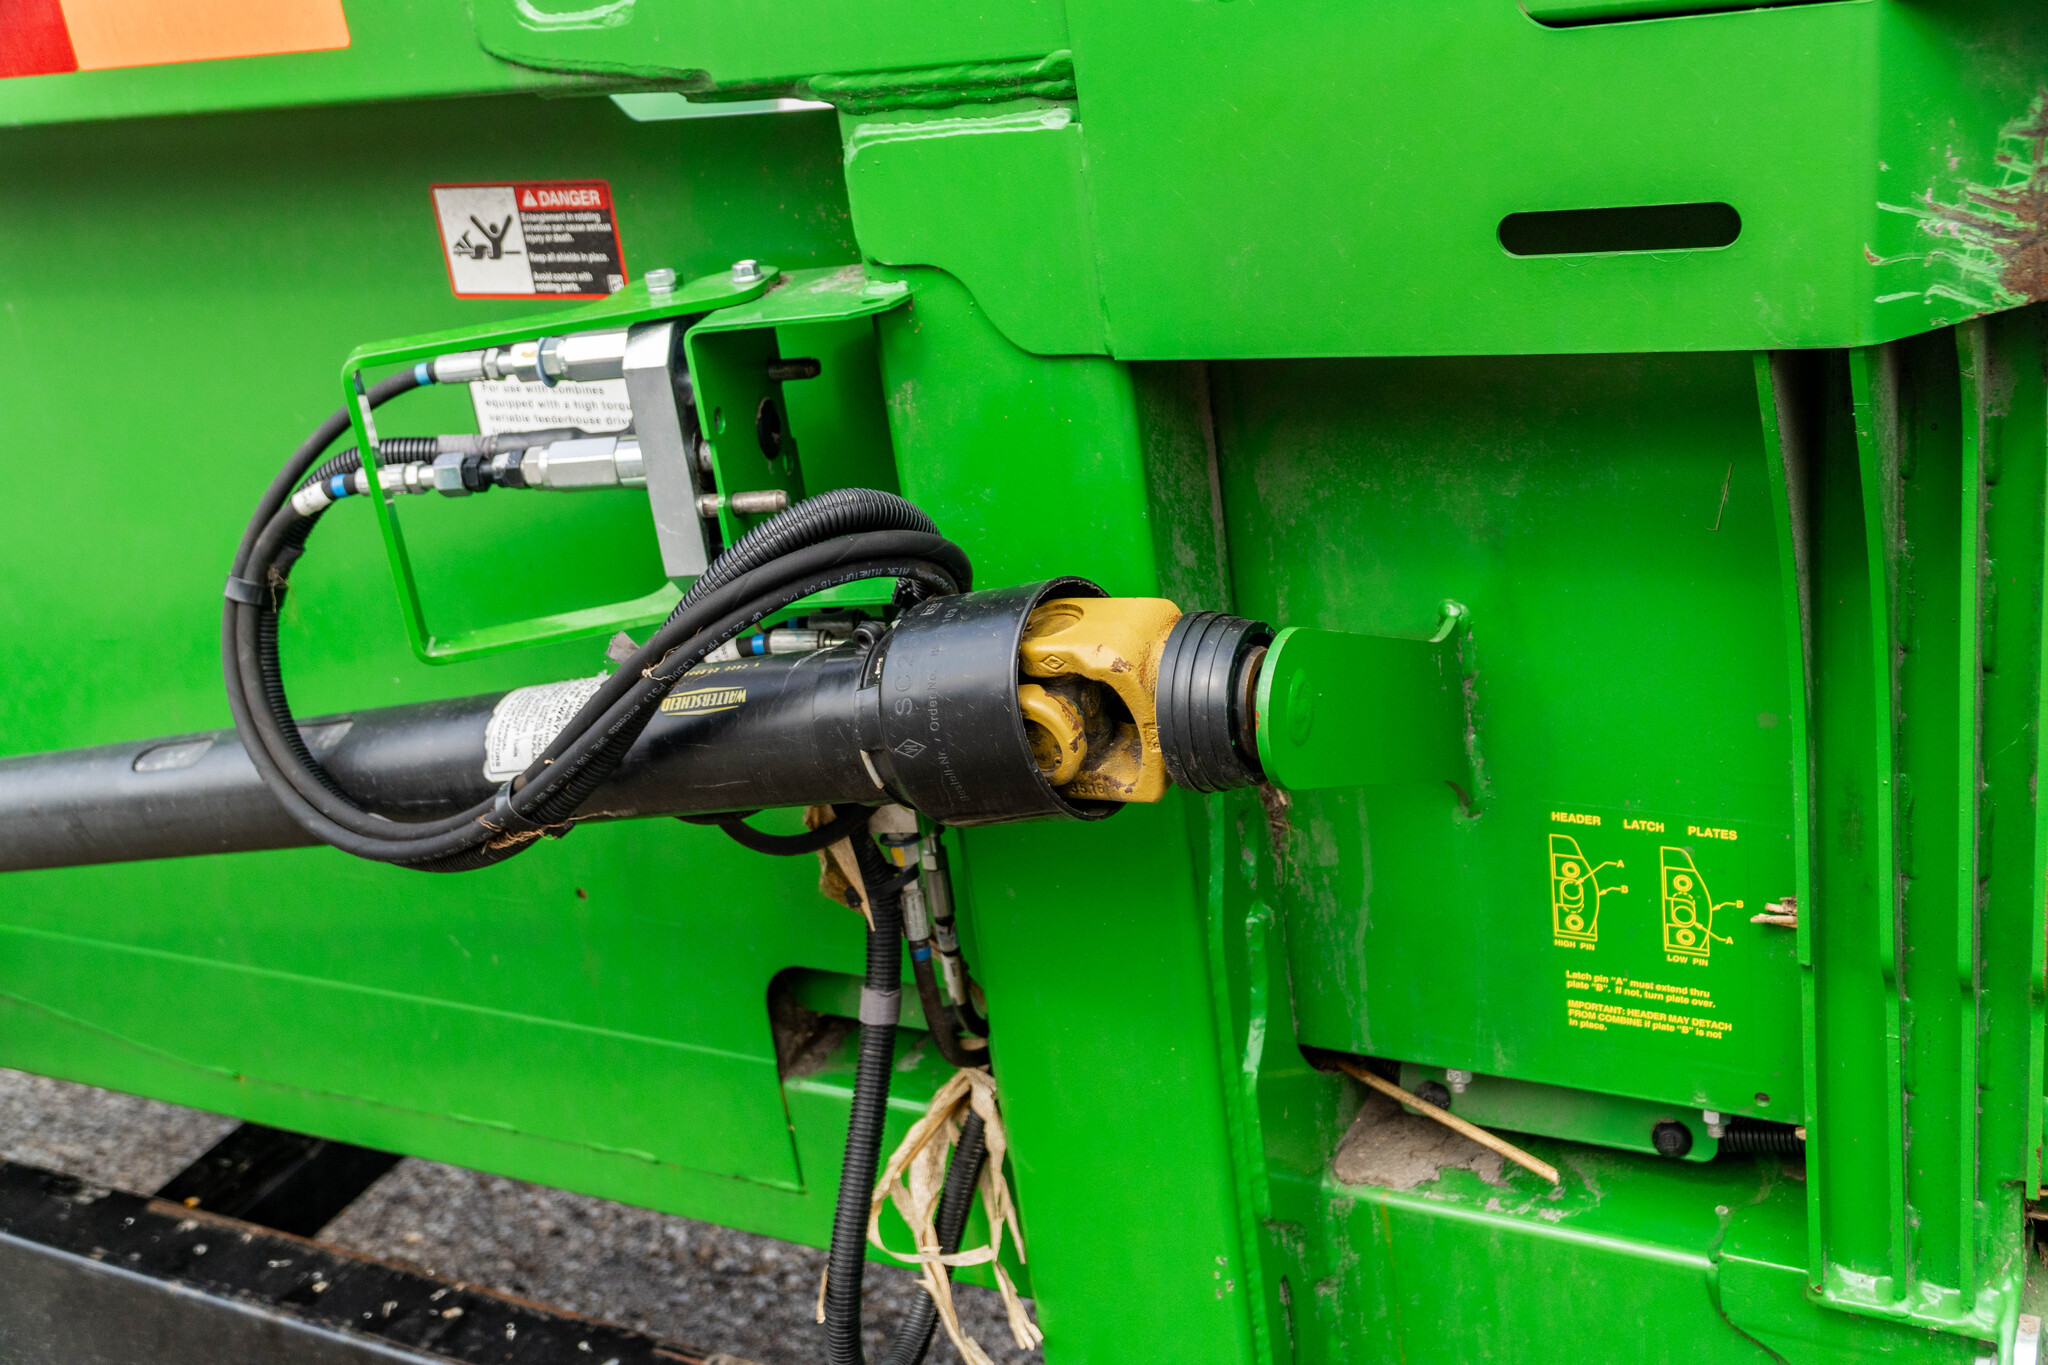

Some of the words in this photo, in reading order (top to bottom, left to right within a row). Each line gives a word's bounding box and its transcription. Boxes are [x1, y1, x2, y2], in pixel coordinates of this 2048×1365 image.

[538, 190, 601, 207] DANGER
[521, 212, 566, 224] Entanglement
[566, 212, 574, 222] in
[574, 212, 601, 224] rotating
[523, 223, 552, 233] driveline
[552, 223, 565, 233] can
[565, 223, 585, 233] cause
[585, 223, 612, 233] serious
[525, 233, 545, 245] injury
[545, 233, 553, 242] or
[553, 233, 575, 243] death.
[529, 252, 547, 263] Keep
[547, 252, 556, 262] all
[556, 251, 581, 262] shields
[580, 252, 588, 262] in
[588, 252, 610, 263] place.
[533, 271, 553, 281] Avoid
[553, 272, 578, 282] contact
[577, 271, 593, 282] with
[535, 282, 562, 293] rotating
[561, 282, 582, 293] parts.
[482, 384, 499, 393] For
[526, 384, 548, 393] with
[552, 386, 606, 394] combines
[485, 399, 534, 409] equipped
[538, 399, 560, 409] with
[574, 401, 599, 411] high
[602, 401, 632, 411] torqu
[490, 413, 531, 423] variable
[534, 414, 601, 425] feederhouse
[751, 611, 763, 622] WP
[722, 620, 748, 639] 22.5
[698, 640, 720, 656] MPa
[668, 659, 696, 683] (3300
[894, 636, 920, 716] SC25
[660, 689, 747, 712] WALTERSCHEID
[608, 704, 640, 735] exceeds
[1551, 811, 1601, 826] HEADER
[1623, 818, 1665, 833] LATCH
[1687, 826, 1738, 841] PLATES
[1616, 859, 1625, 868] A
[1620, 884, 1629, 894] B
[1736, 900, 1744, 909] B
[1554, 938, 1576, 949] HIGH
[1580, 941, 1595, 951] PIN
[1725, 936, 1734, 945] A
[1666, 954, 1688, 964] LOW
[1692, 956, 1709, 967] PIN
[1565, 970, 1592, 981] Latch
[1593, 974, 1609, 984] pin
[1610, 976, 1628, 985] "A"
[1629, 980, 1654, 990] must
[1655, 984, 1688, 995] extend
[1689, 987, 1710, 998] thru
[1566, 980, 1590, 990] plate
[1615, 986, 1622, 995] If
[1623, 988, 1643, 999] not,
[1644, 990, 1664, 1000] turn
[1665, 994, 1690, 1004] plate
[1567, 999, 1625, 1015] IMPORTANT:
[1627, 1008, 1667, 1022] HEADER
[1668, 1014, 1690, 1025] MAY
[1691, 1018, 1732, 1032] DETACH
[1568, 1018, 1578, 1026] in
[1568, 1008, 1597, 1020] FROM
[1598, 1013, 1643, 1027] COMBINE
[1644, 1020, 1651, 1028] if
[1652, 1022, 1675, 1032] plate
[1676, 1025, 1694, 1034] "B"
[1695, 1027, 1705, 1036] is
[1706, 1030, 1723, 1039] not
